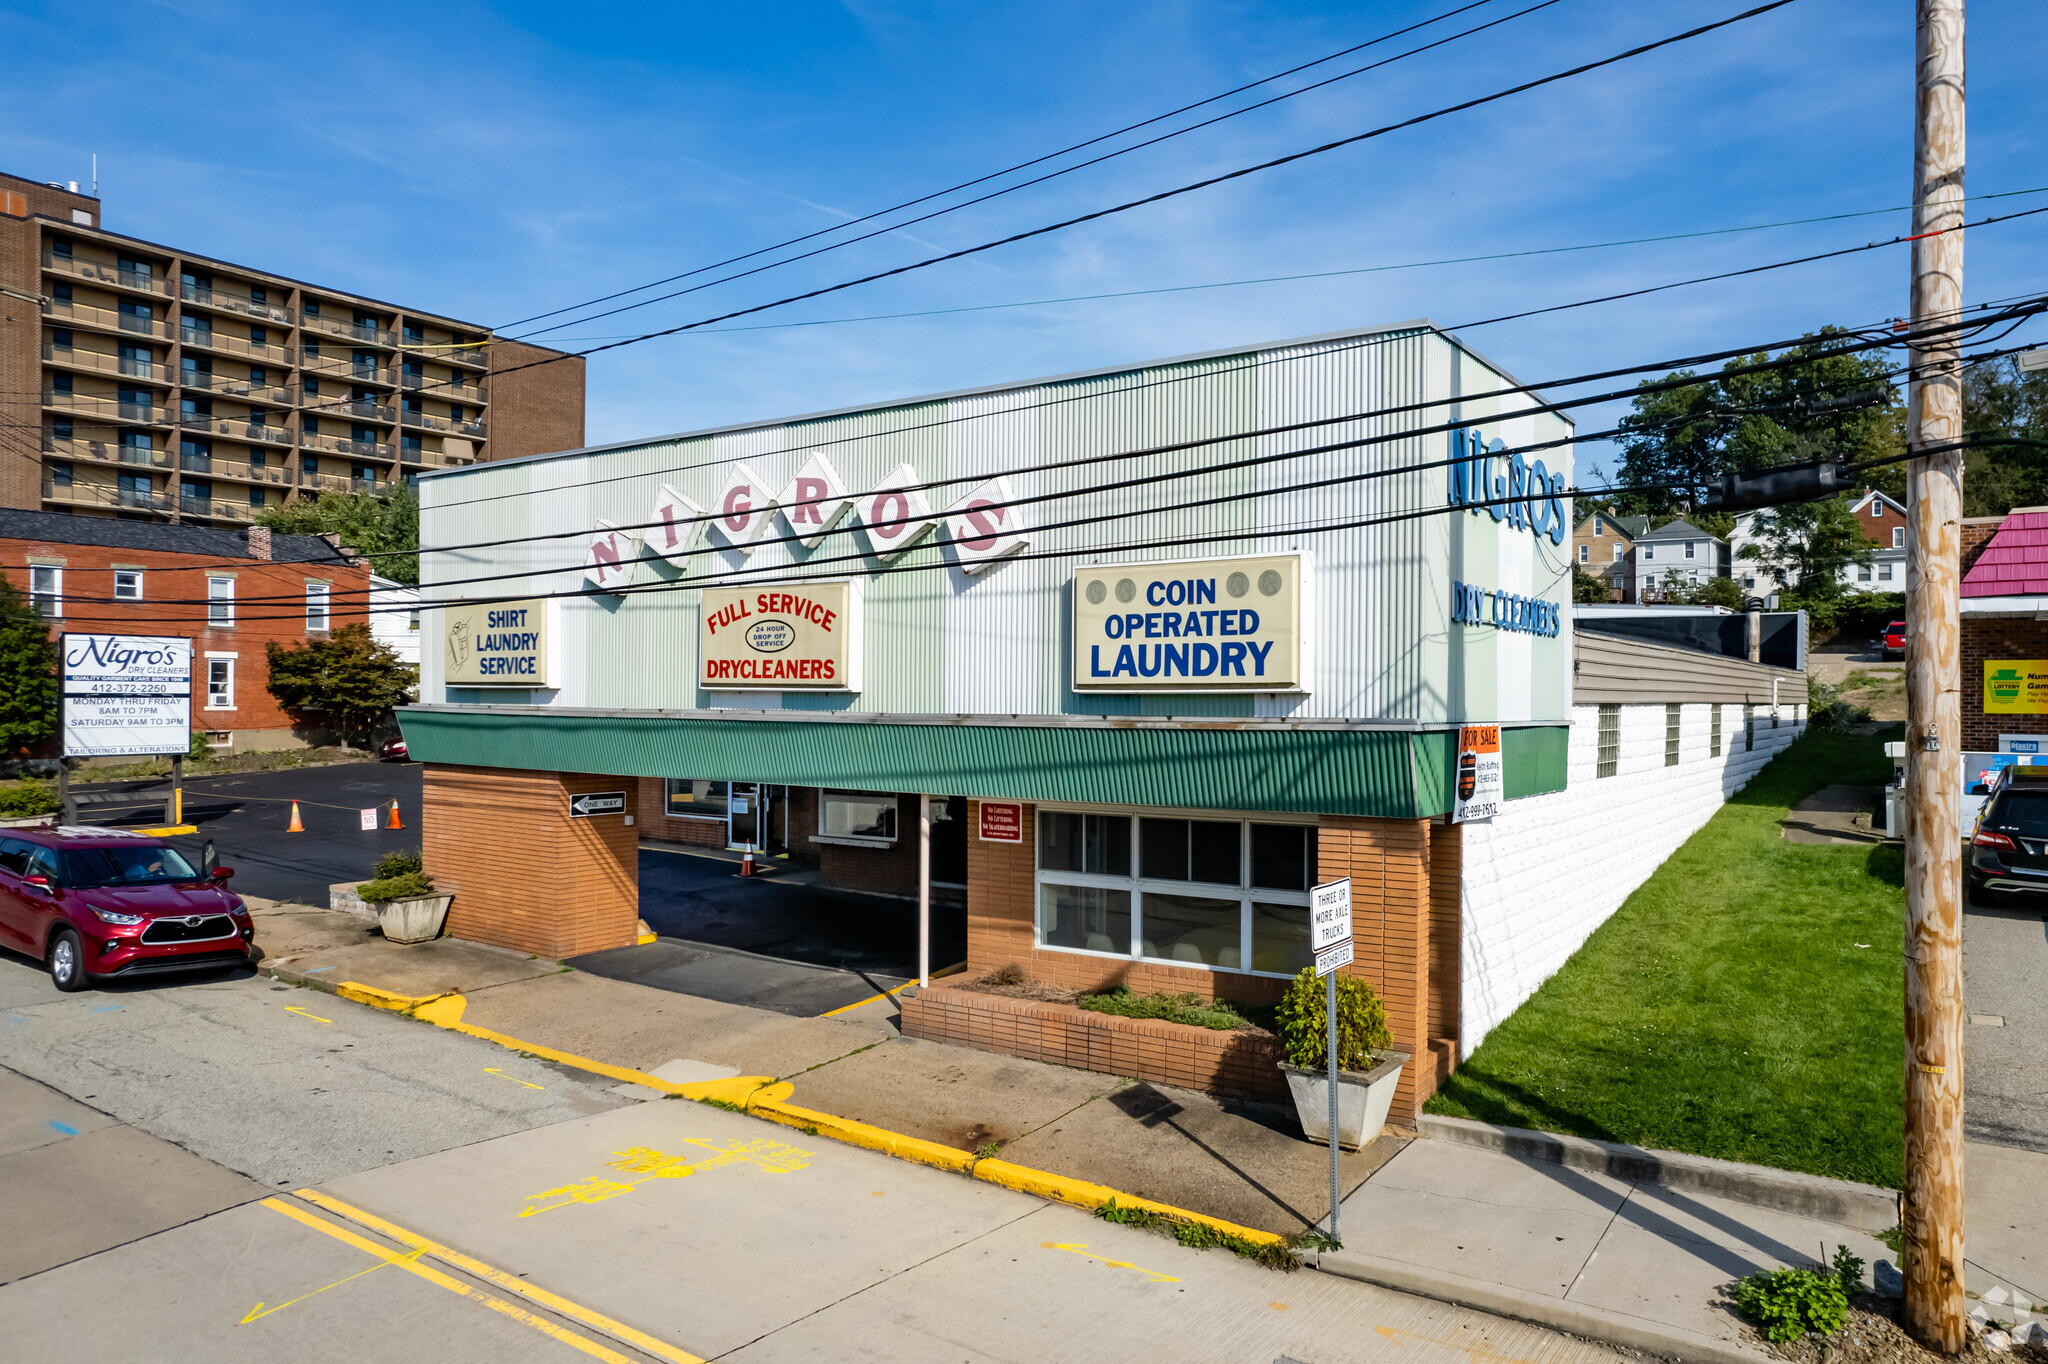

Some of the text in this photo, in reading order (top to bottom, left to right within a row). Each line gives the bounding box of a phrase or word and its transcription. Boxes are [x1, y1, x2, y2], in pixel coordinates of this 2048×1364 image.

[1449, 416, 1565, 545] NIGROS
[591, 477, 1007, 583] NIGROS
[1146, 578, 1216, 607] COIN
[487, 609, 528, 628] SHIRT
[707, 593, 837, 635] FULL SERVICE
[1452, 580, 1560, 638] DRY CLEANERS
[1104, 608, 1260, 639] OPERATED
[476, 632, 539, 652] LAUNDRY
[66, 636, 177, 674] Nigro's
[1090, 640, 1274, 677] LAUNDRY
[128, 666, 189, 675] DRY CLEANERS
[479, 656, 536, 675] SERVICE
[707, 659, 835, 679] DRYCLEANERS
[91, 684, 167, 693] 412-372-2250
[71, 718, 124, 726] SATURDAY
[1463, 729, 1497, 746] FOR SALE
[364, 815, 374, 824] NO
[1458, 802, 1498, 819] 412-999-7612
[1318, 888, 1346, 907] THREE OR
[1316, 904, 1348, 925] MORE AXLE
[1322, 923, 1344, 941] TRUCKS
[1319, 947, 1350, 971] PROHIBITED
